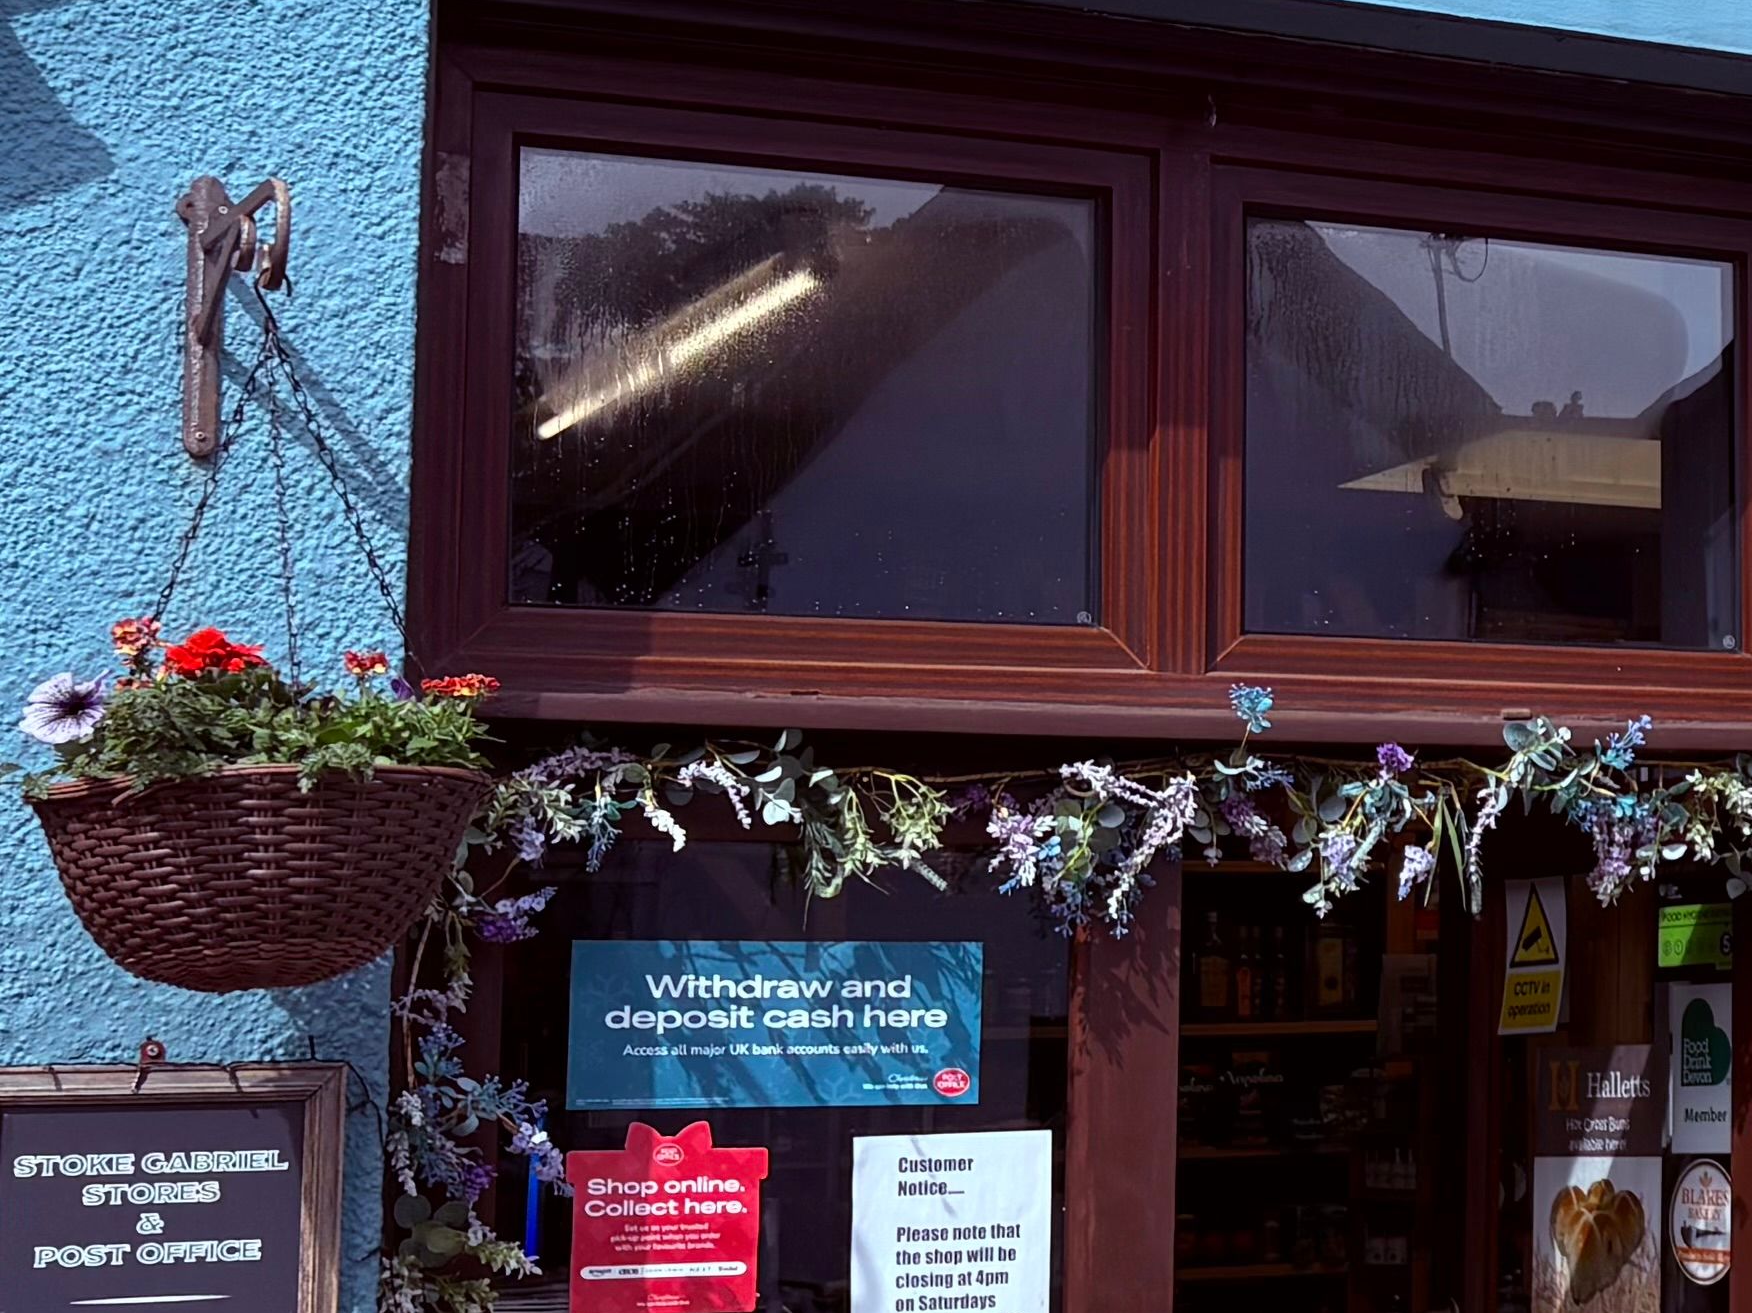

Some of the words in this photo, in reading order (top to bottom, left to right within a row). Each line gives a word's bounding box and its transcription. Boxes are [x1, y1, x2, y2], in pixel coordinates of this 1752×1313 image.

[645, 974, 833, 999] Withdraw
[841, 975, 912, 998] and
[604, 1005, 754, 1034] deposit
[762, 1005, 854, 1029] cash
[863, 1005, 948, 1028] here
[622, 1044, 668, 1057] Access
[671, 1043, 688, 1056] all
[690, 1044, 726, 1058] major
[729, 1043, 750, 1056] UK
[752, 1043, 784, 1056] bank
[786, 1043, 840, 1055] accounts
[880, 1042, 908, 1055] with
[1587, 1071, 1651, 1098] Halletts
[1684, 1107, 1727, 1122] Member
[13, 1153, 135, 1178] STOKE
[141, 1150, 289, 1175] GABRIEL
[898, 1157, 974, 1173] Customer
[82, 1181, 220, 1205] STORES
[587, 1178, 658, 1197] Shop
[664, 1176, 746, 1193] online.
[584, 1199, 679, 1217] Collect
[684, 1197, 748, 1215] here.
[136, 1213, 164, 1234] &
[897, 1227, 949, 1242] Please
[953, 1225, 987, 1240] note
[990, 1223, 1021, 1239] that
[33, 1243, 131, 1268] POST
[136, 1239, 262, 1264] OFFICE
[896, 1249, 921, 1265] the
[925, 1249, 962, 1265] shop
[966, 1246, 994, 1263] will
[998, 1246, 1017, 1262] be
[895, 1271, 953, 1289] closing
[957, 1271, 972, 1286] at
[975, 1270, 1009, 1286] 4pm
[895, 1298, 914, 1312] on
[918, 1293, 996, 1311] Saturdays
